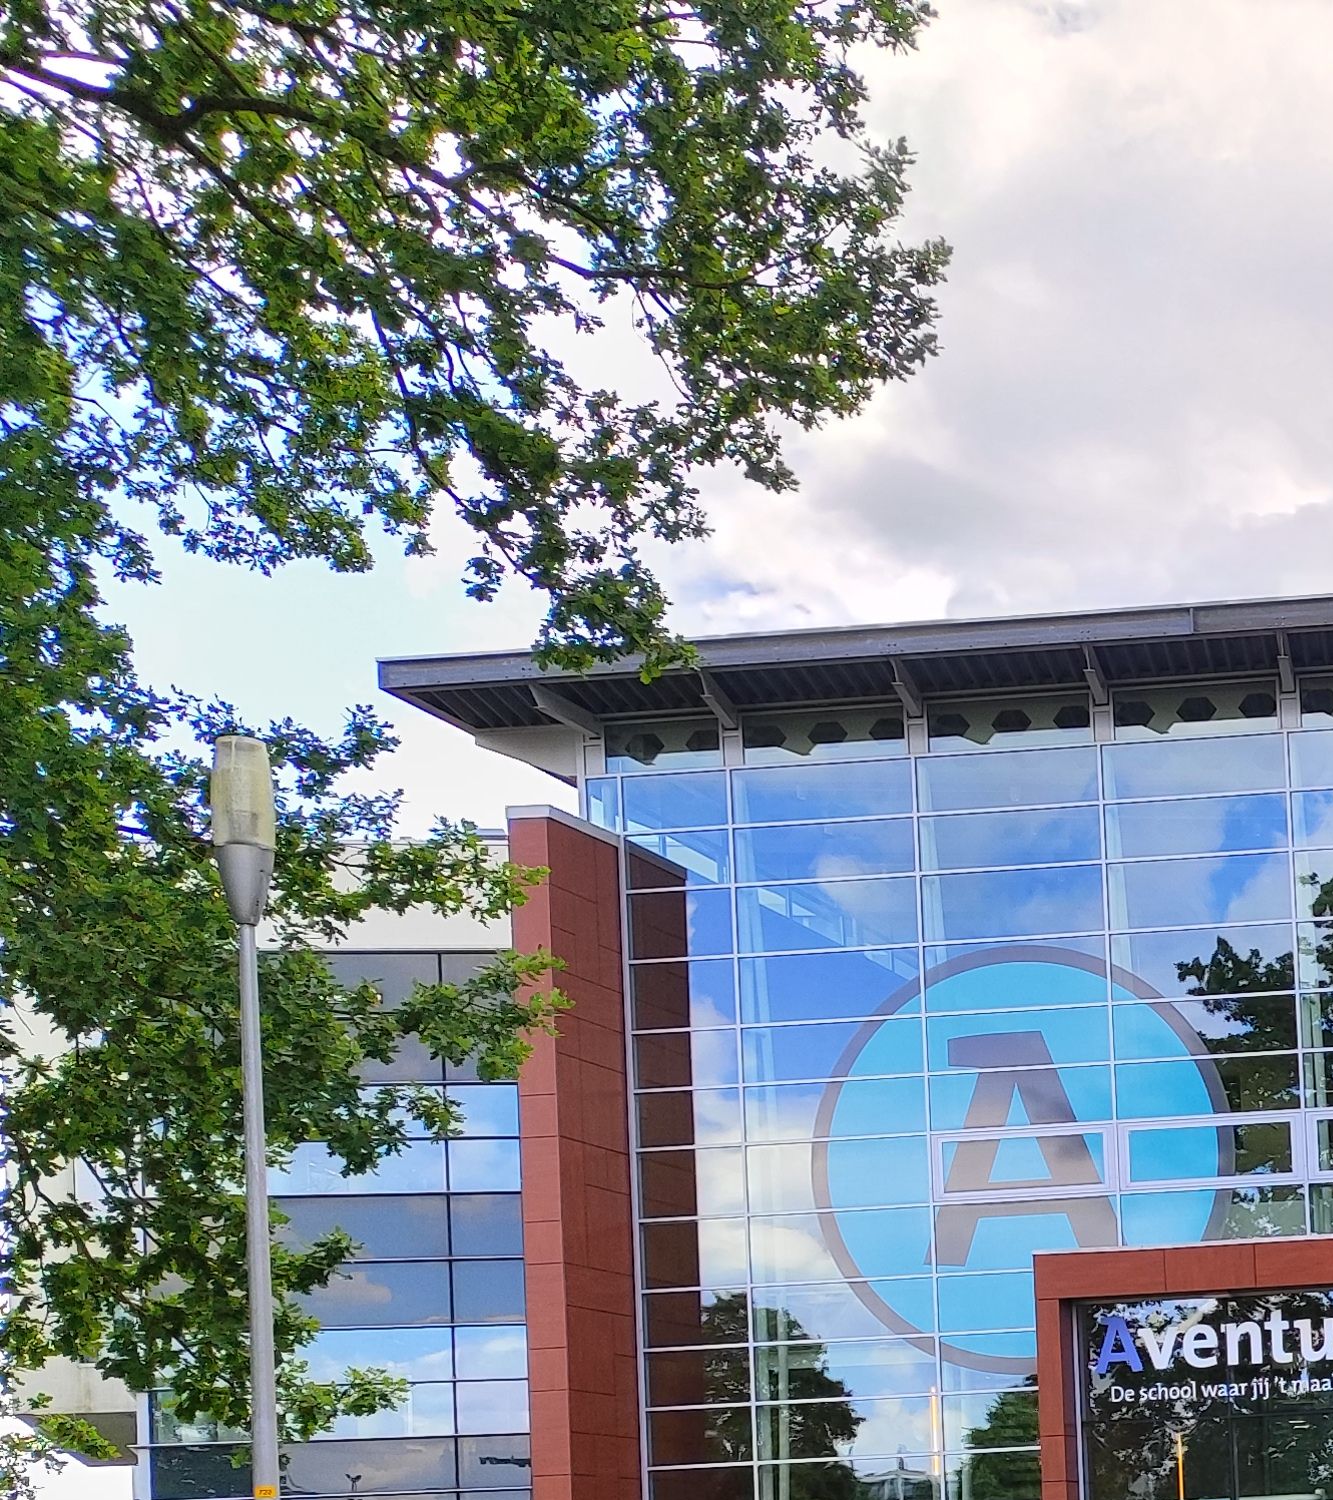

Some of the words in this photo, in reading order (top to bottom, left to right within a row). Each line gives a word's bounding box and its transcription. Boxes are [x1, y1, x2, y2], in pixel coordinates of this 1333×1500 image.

[924, 1030, 1119, 1267] A
[1111, 1385, 1135, 1403] De
[1140, 1380, 1198, 1402] school
[1201, 1382, 1248, 1399] waar
[1250, 1376, 1270, 1401] jij
